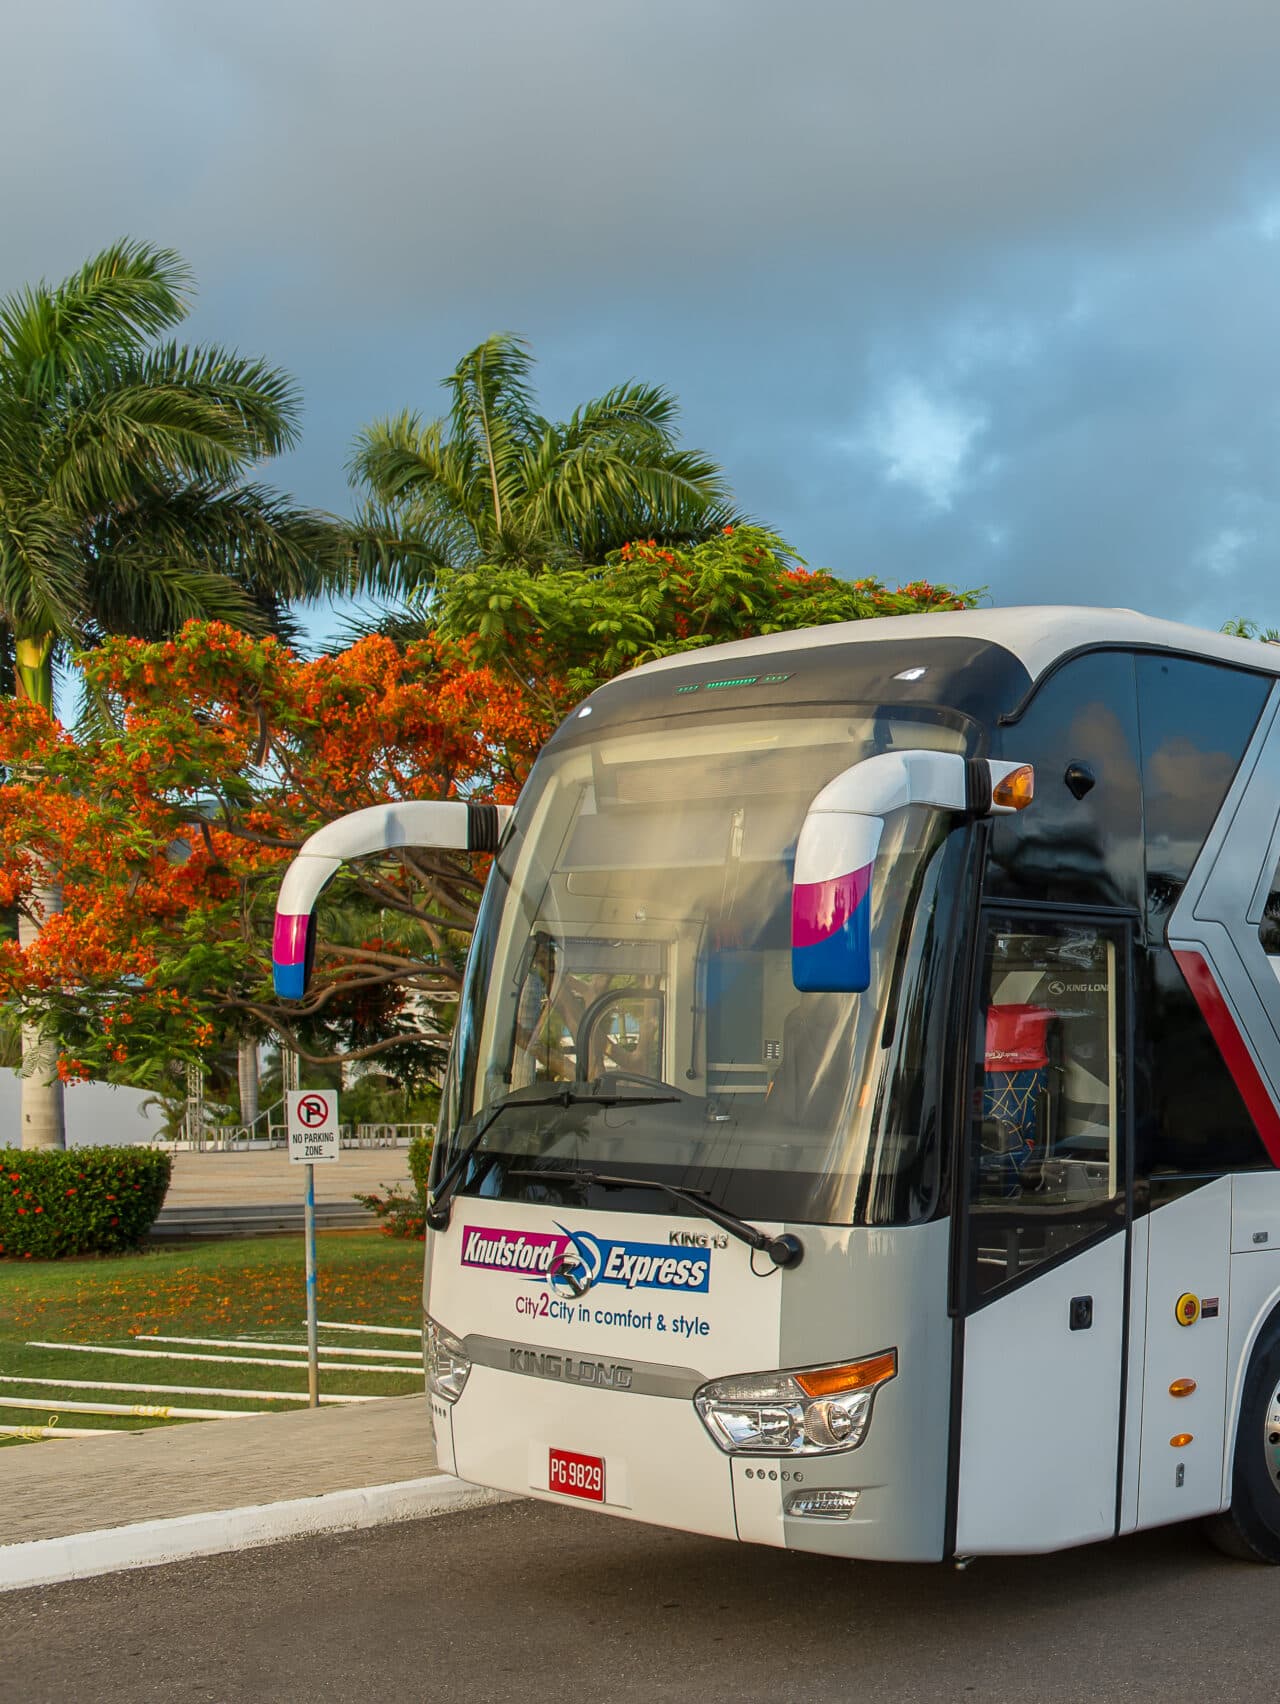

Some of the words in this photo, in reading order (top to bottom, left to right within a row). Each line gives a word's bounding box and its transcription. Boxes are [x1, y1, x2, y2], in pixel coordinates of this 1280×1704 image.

[292, 1133, 302, 1144] NO
[304, 1132, 334, 1143] PARKING
[305, 1145, 323, 1156] ZONE
[668, 1231, 709, 1248] KING
[710, 1233, 729, 1249] 13
[463, 1231, 557, 1272] Knutsford
[603, 1246, 709, 1289] Express
[578, 1304, 590, 1322] in
[595, 1309, 652, 1330] comfort
[657, 1314, 667, 1332] &
[672, 1316, 710, 1339] style
[510, 1348, 562, 1377] KING
[565, 1358, 633, 1388] LONG
[551, 1458, 567, 1484] PG
[569, 1462, 601, 1491] 9829
